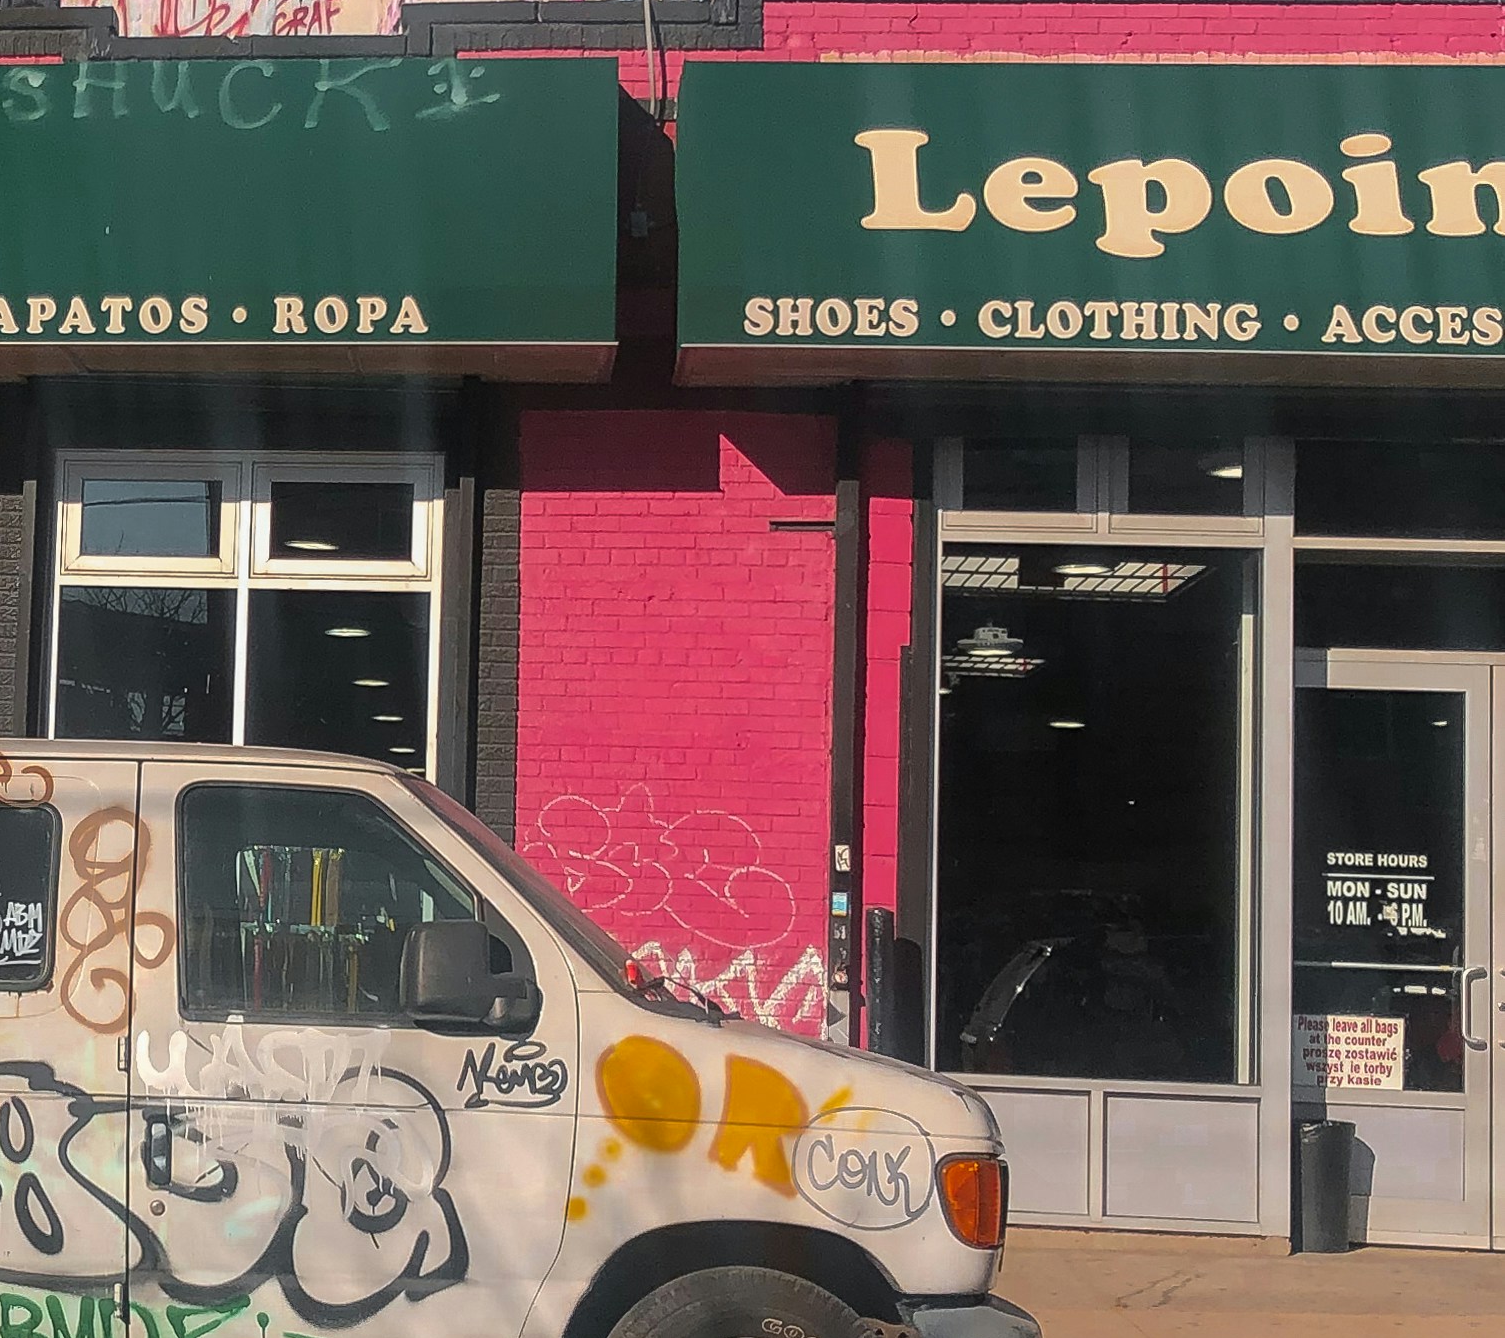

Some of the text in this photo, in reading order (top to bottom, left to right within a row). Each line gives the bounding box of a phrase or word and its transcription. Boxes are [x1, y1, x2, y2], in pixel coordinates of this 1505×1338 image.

[853, 127, 1505, 259] Lepoin
[272, 295, 430, 336] ROPA
[743, 296, 1504, 346] SHOES CLOTHING ACCES
[1326, 852, 1428, 869] STORE HOURS
[1326, 881, 1371, 898] MON
[1386, 883, 1427, 900] SUN
[1327, 900, 1343, 925] 10
[1297, 1016, 1399, 1037] Please leave all bags
[1309, 1033, 1387, 1047] at the counter
[1363, 1062, 1393, 1078] torby
[1316, 1074, 1383, 1088] przy kasie
